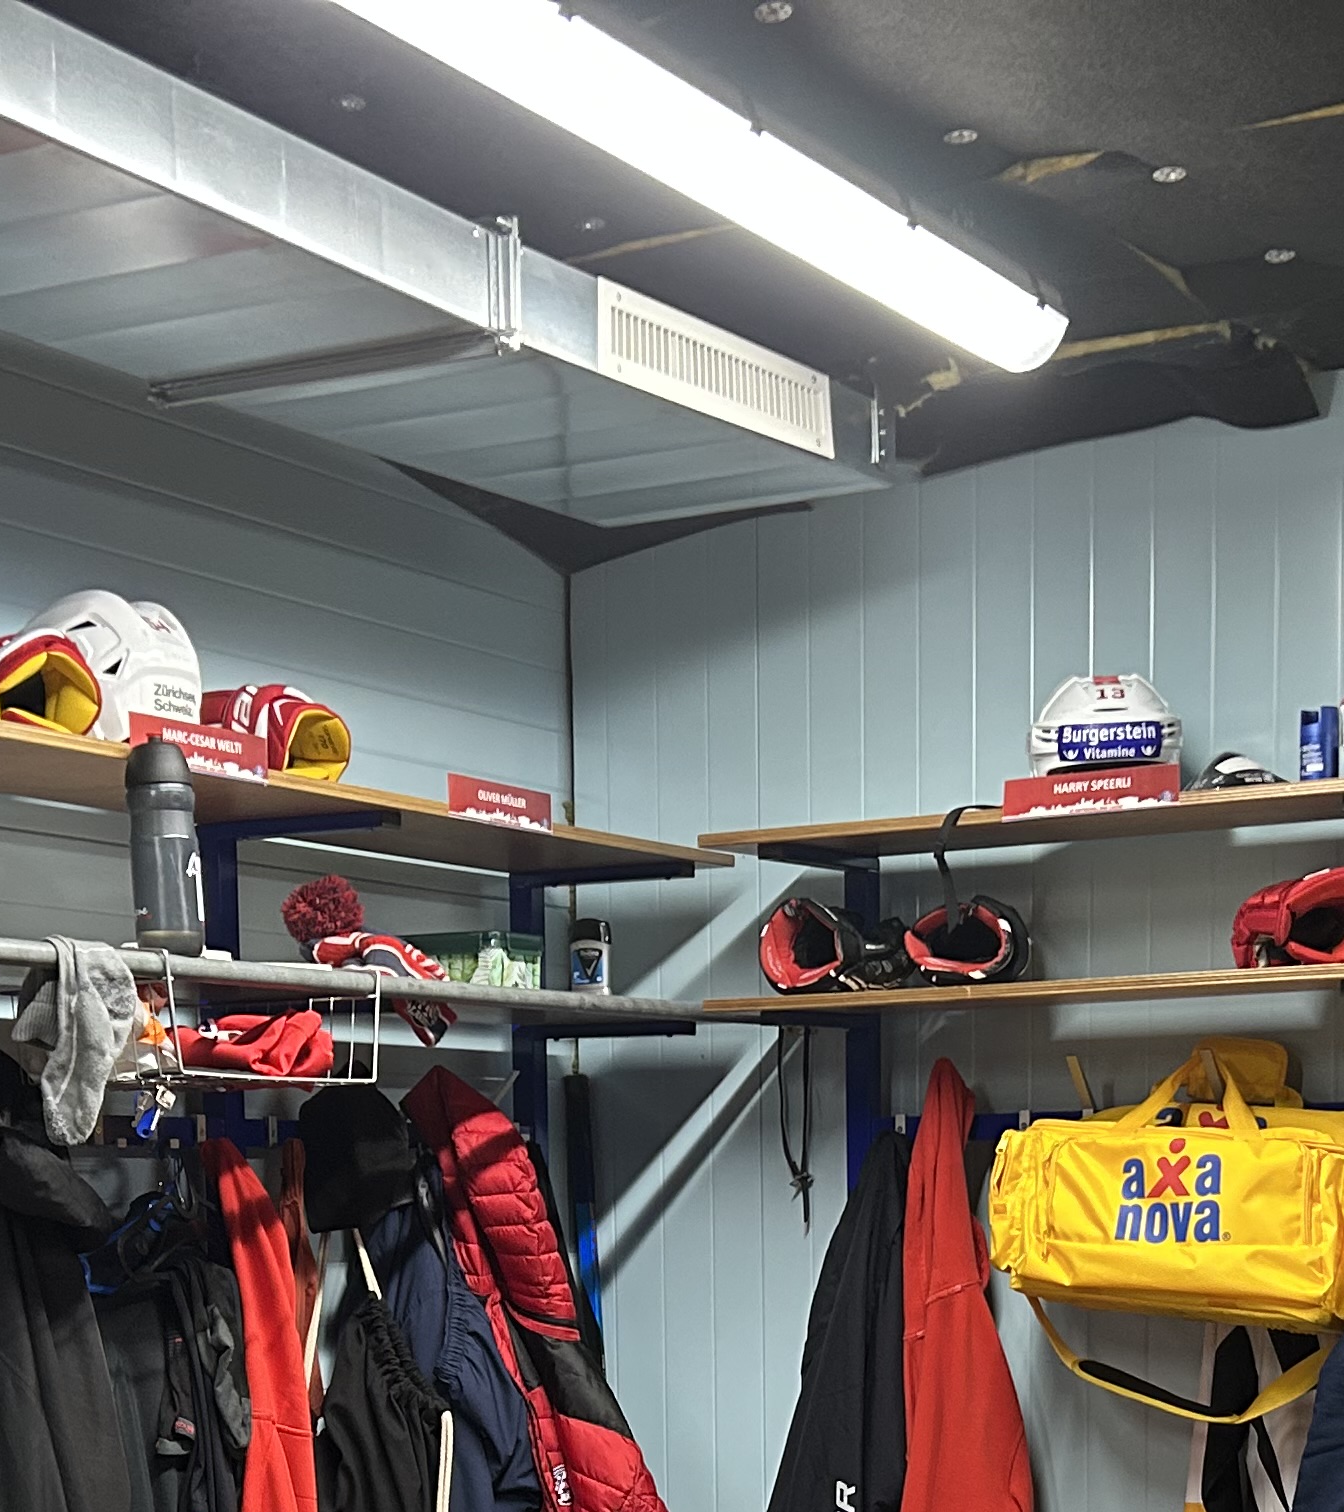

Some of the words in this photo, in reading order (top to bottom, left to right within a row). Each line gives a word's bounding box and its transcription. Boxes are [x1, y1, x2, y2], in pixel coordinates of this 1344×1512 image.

[1095, 687, 1126, 701] 13
[162, 727, 217, 750] MARC-CESAR
[217, 739, 244, 755] WELTI
[1062, 722, 1157, 746] Burgerstein
[1083, 745, 1136, 760] Vitamine
[1053, 780, 1090, 795] HARRY
[1090, 776, 1132, 792] SPEERLI
[477, 789, 501, 804] OLIVER
[501, 793, 527, 809] MÜLLER
